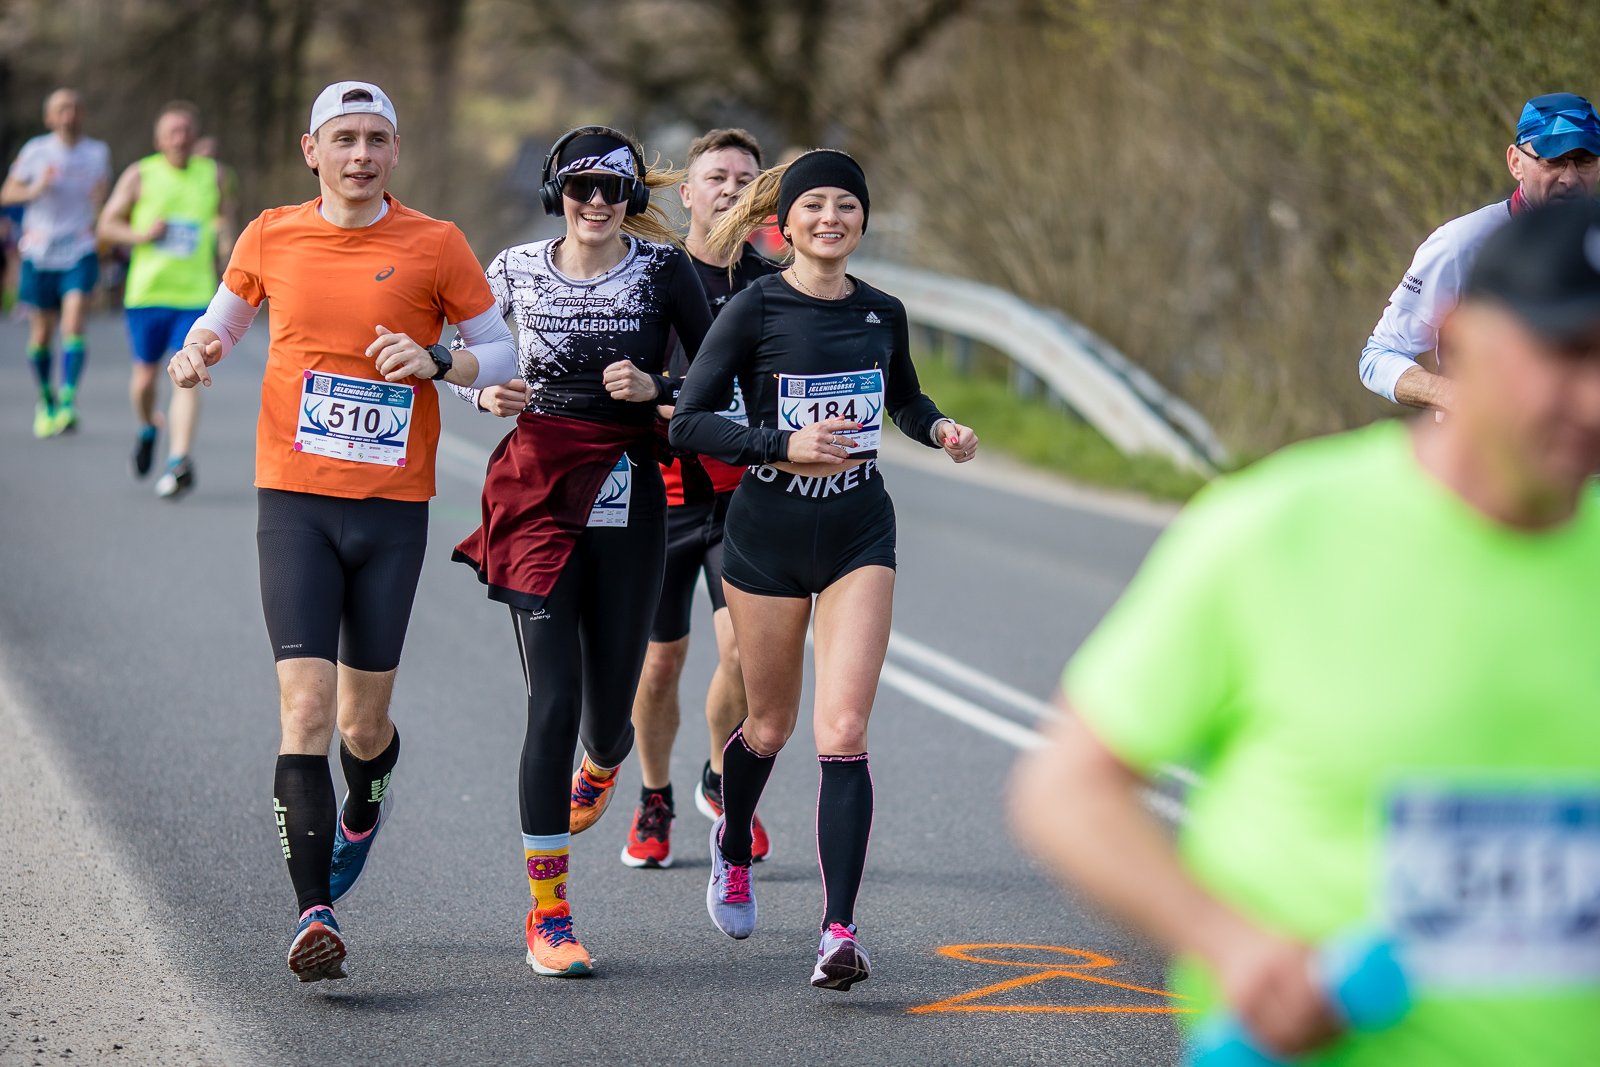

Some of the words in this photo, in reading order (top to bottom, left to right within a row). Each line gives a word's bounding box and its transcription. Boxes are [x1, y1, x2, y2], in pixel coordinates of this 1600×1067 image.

[527, 314, 640, 332] RUNMAGEDDON
[328, 402, 381, 434] 510
[808, 398, 857, 423] 184
[786, 465, 860, 498] NIKE
